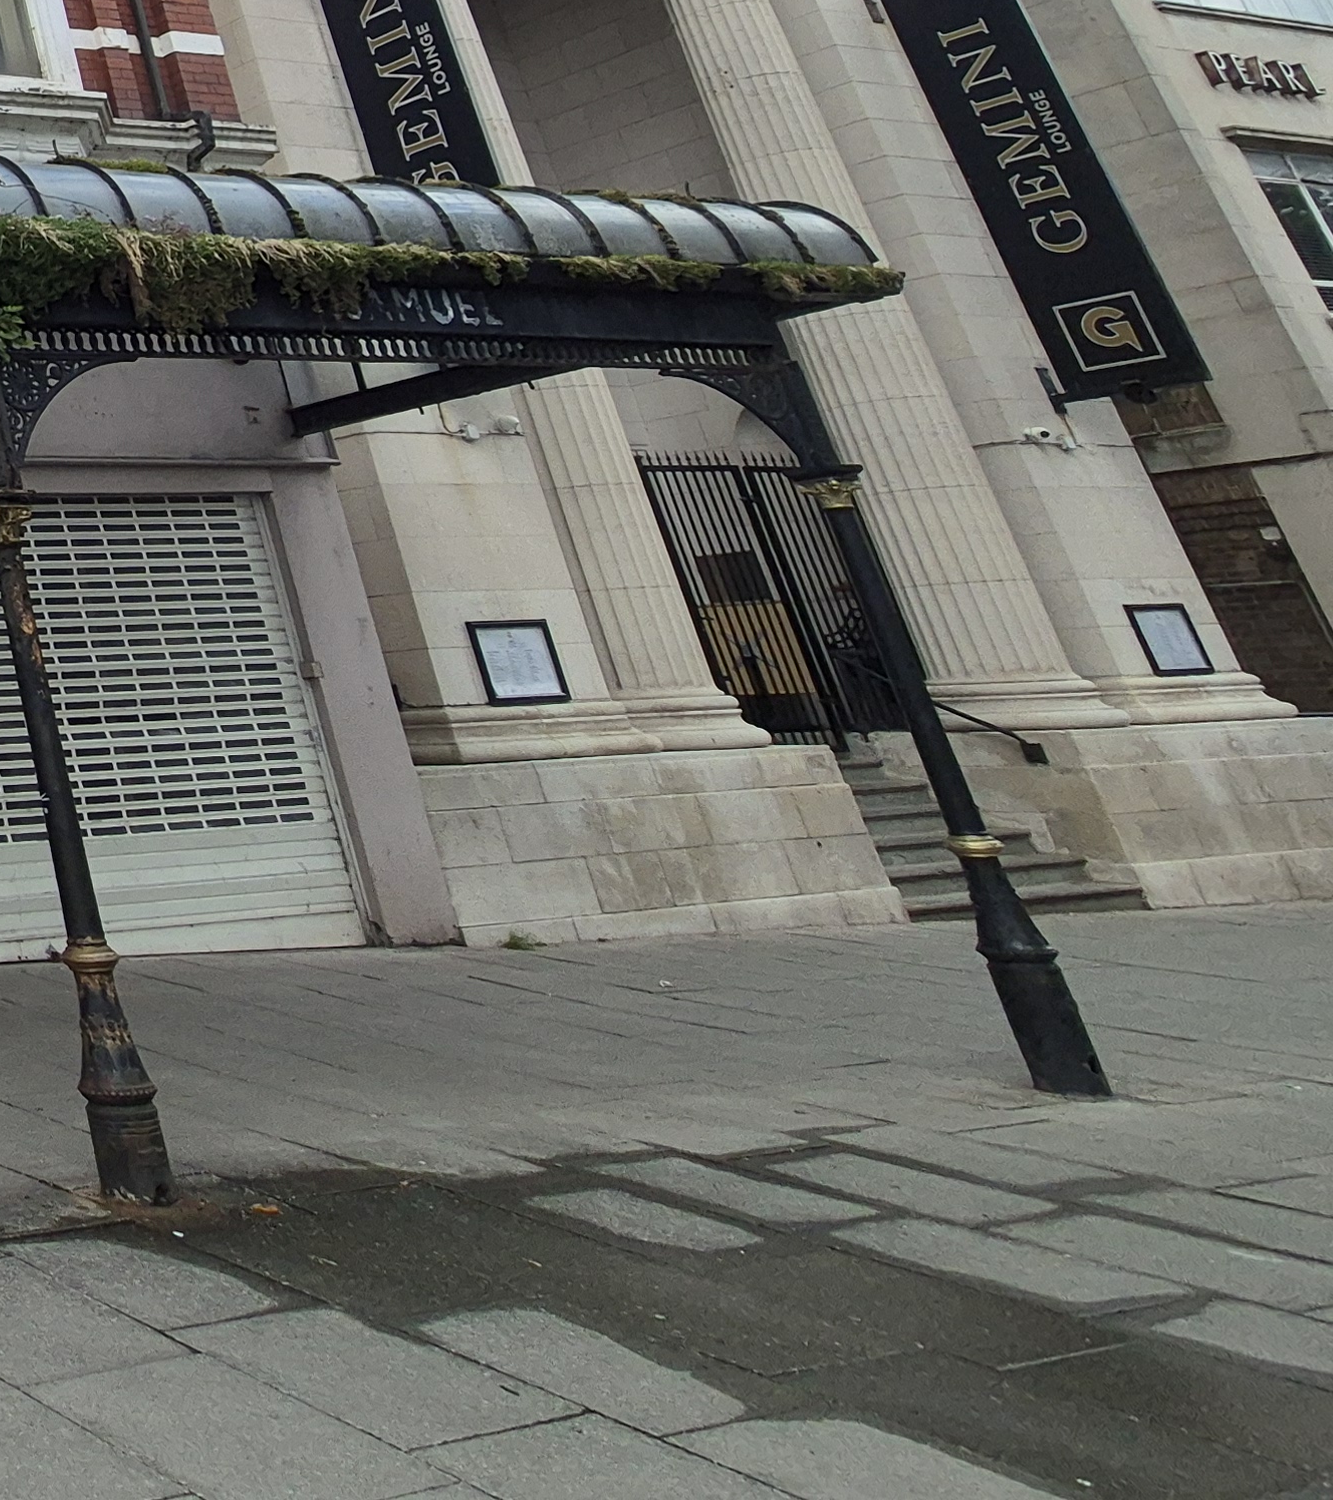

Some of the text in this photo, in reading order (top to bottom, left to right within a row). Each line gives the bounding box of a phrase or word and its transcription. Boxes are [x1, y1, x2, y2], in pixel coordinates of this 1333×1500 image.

[415, 21, 451, 96] LOUNGE
[1196, 50, 1327, 97] PEARL
[936, 17, 1089, 254] GEMINI
[1029, 89, 1073, 155] LOUNGE
[1080, 305, 1144, 353] G
